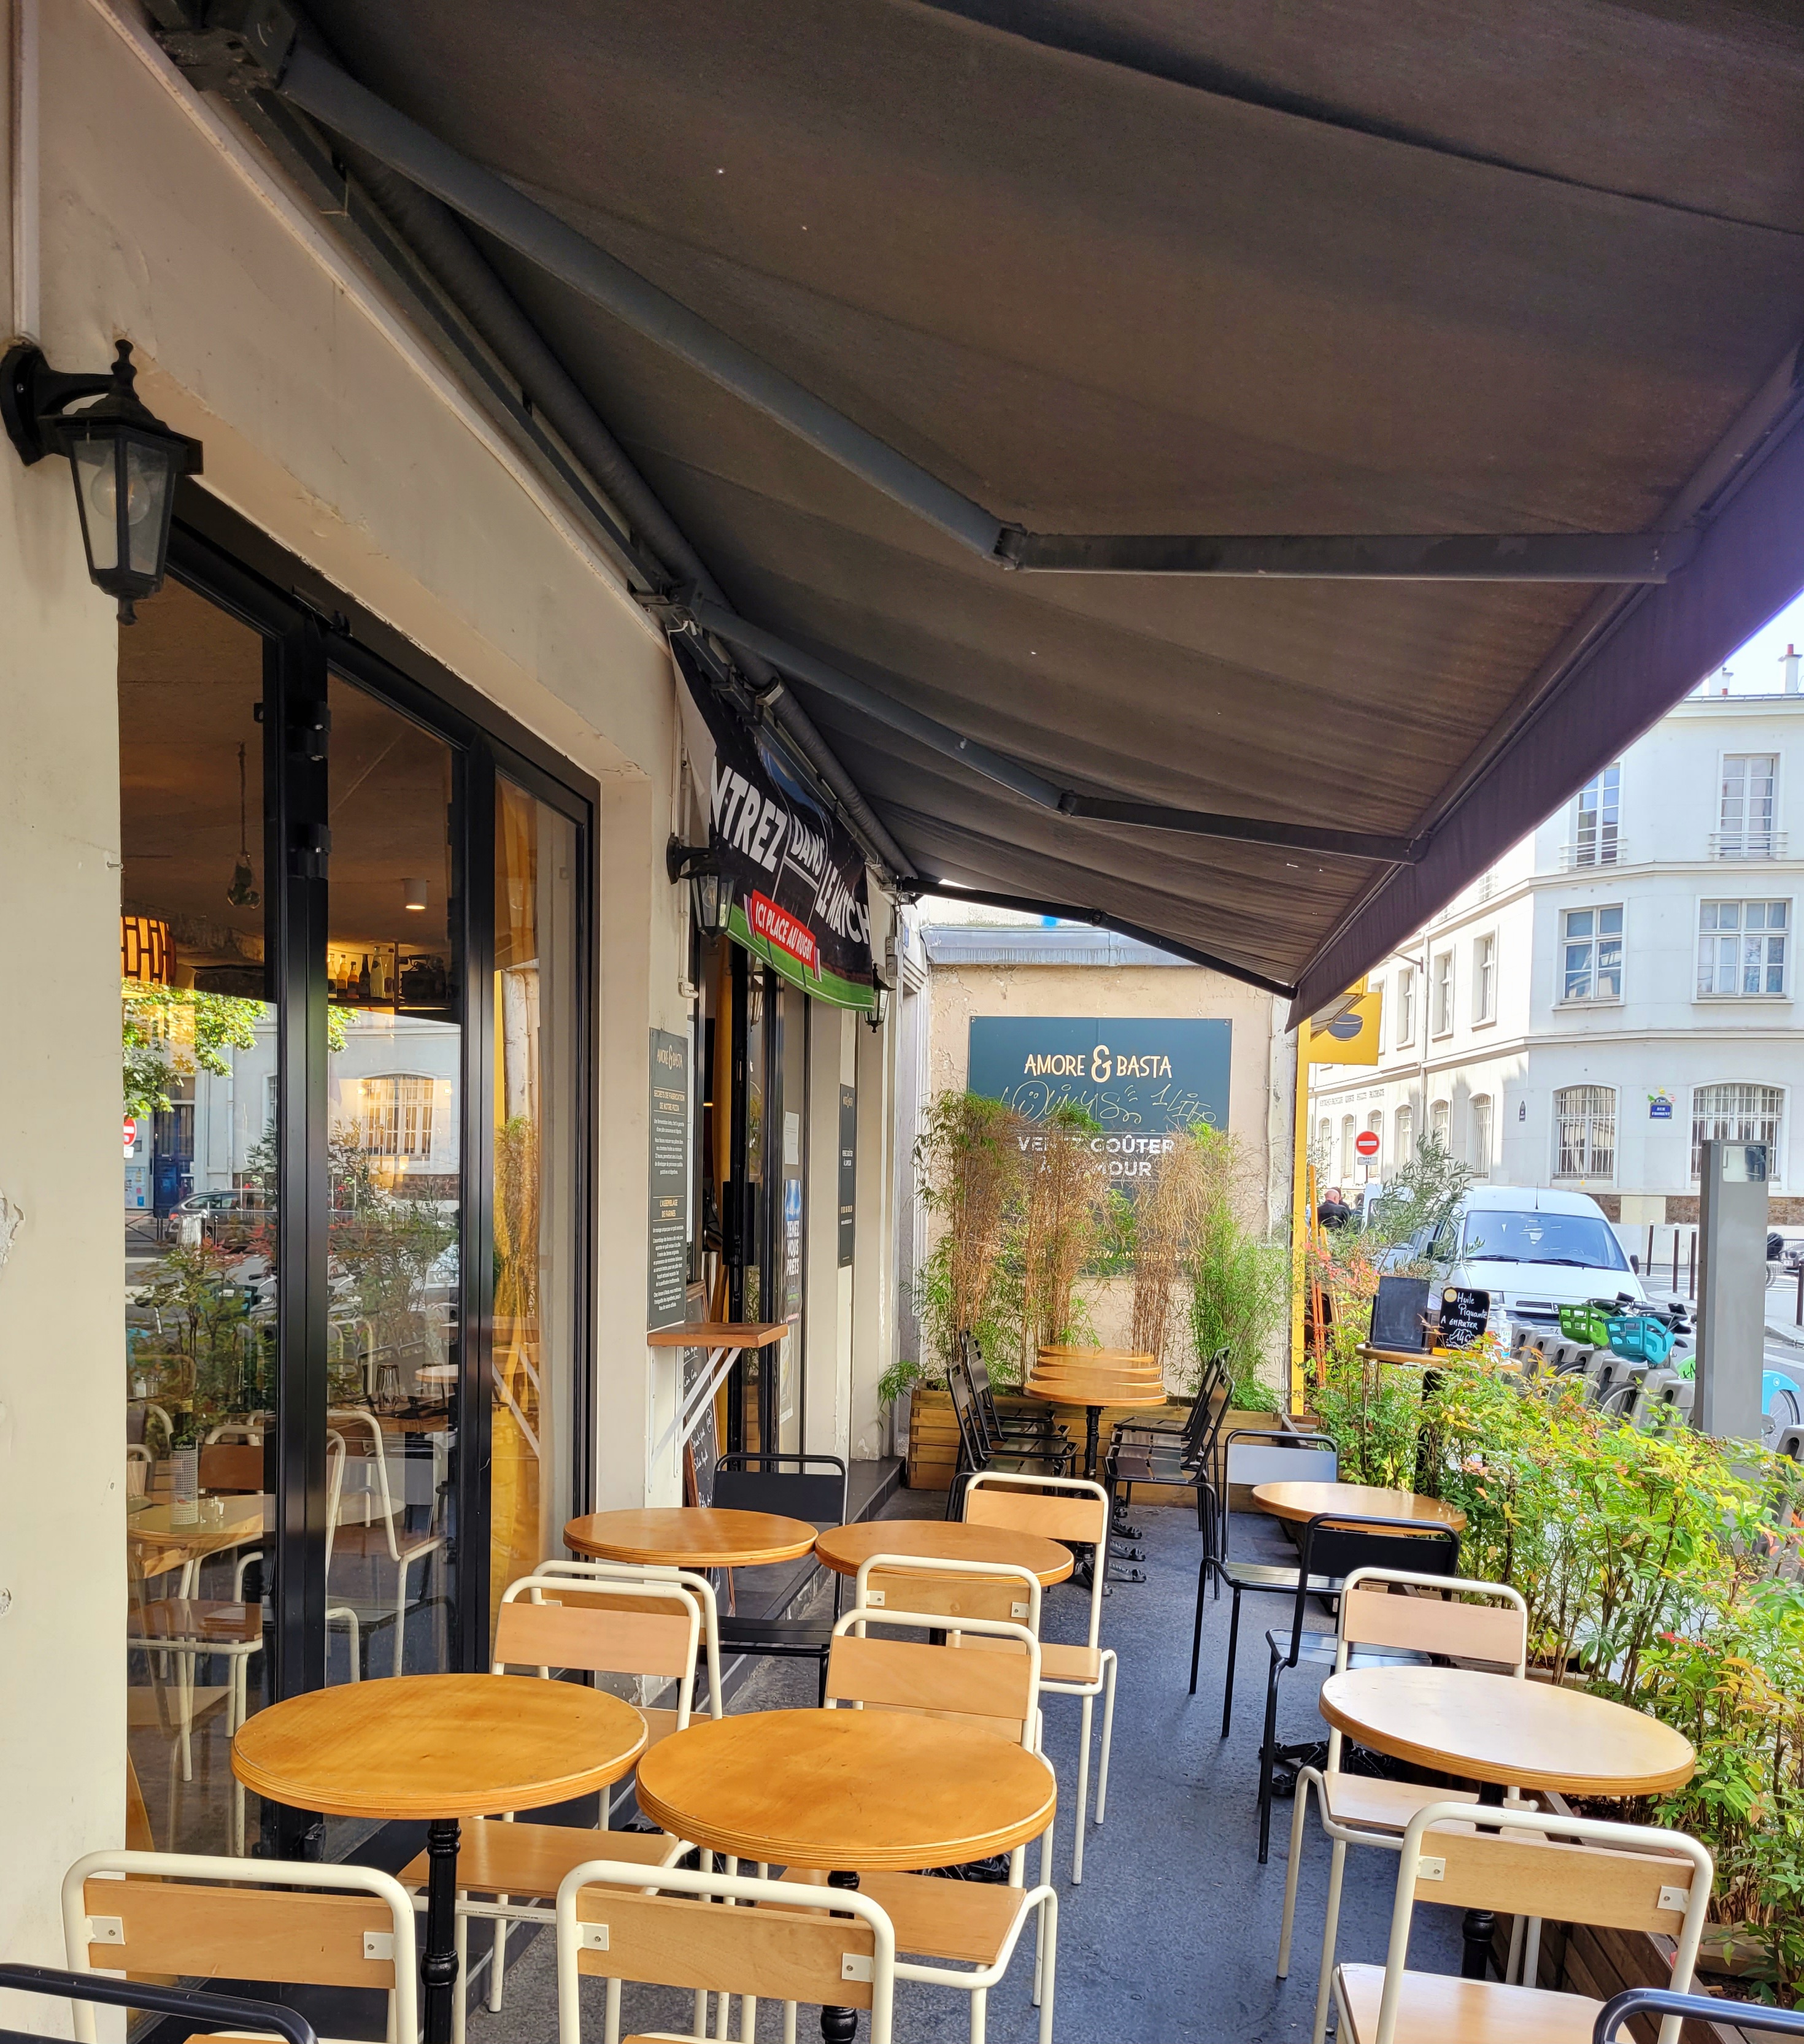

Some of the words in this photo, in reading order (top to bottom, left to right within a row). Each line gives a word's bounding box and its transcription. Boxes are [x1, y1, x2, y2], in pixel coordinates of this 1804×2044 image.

[790, 813, 825, 877] DANS
[815, 860, 838, 919] LE
[825, 874, 871, 944] MATCH
[755, 901, 767, 929] ICI
[766, 909, 790, 944] PLACE
[786, 925, 799, 950] AU
[795, 931, 813, 962] RUGBY
[657, 1048, 668, 1065] AMORE
[668, 1045, 673, 1070] &
[1023, 1054, 1086, 1077] AMORE
[1091, 1045, 1112, 1083] &
[1116, 1055, 1173, 1078] BASTA
[1090, 1134, 1175, 1154] GOÛTER
[787, 1220, 800, 1238] TENEZ
[787, 1239, 799, 1257] VOUS
[1457, 1291, 1474, 1305] Huile
[1440, 1315, 1446, 1324] A
[1449, 1318, 1478, 1331] EMPORTER
[1458, 1303, 1488, 1321] Piquante
